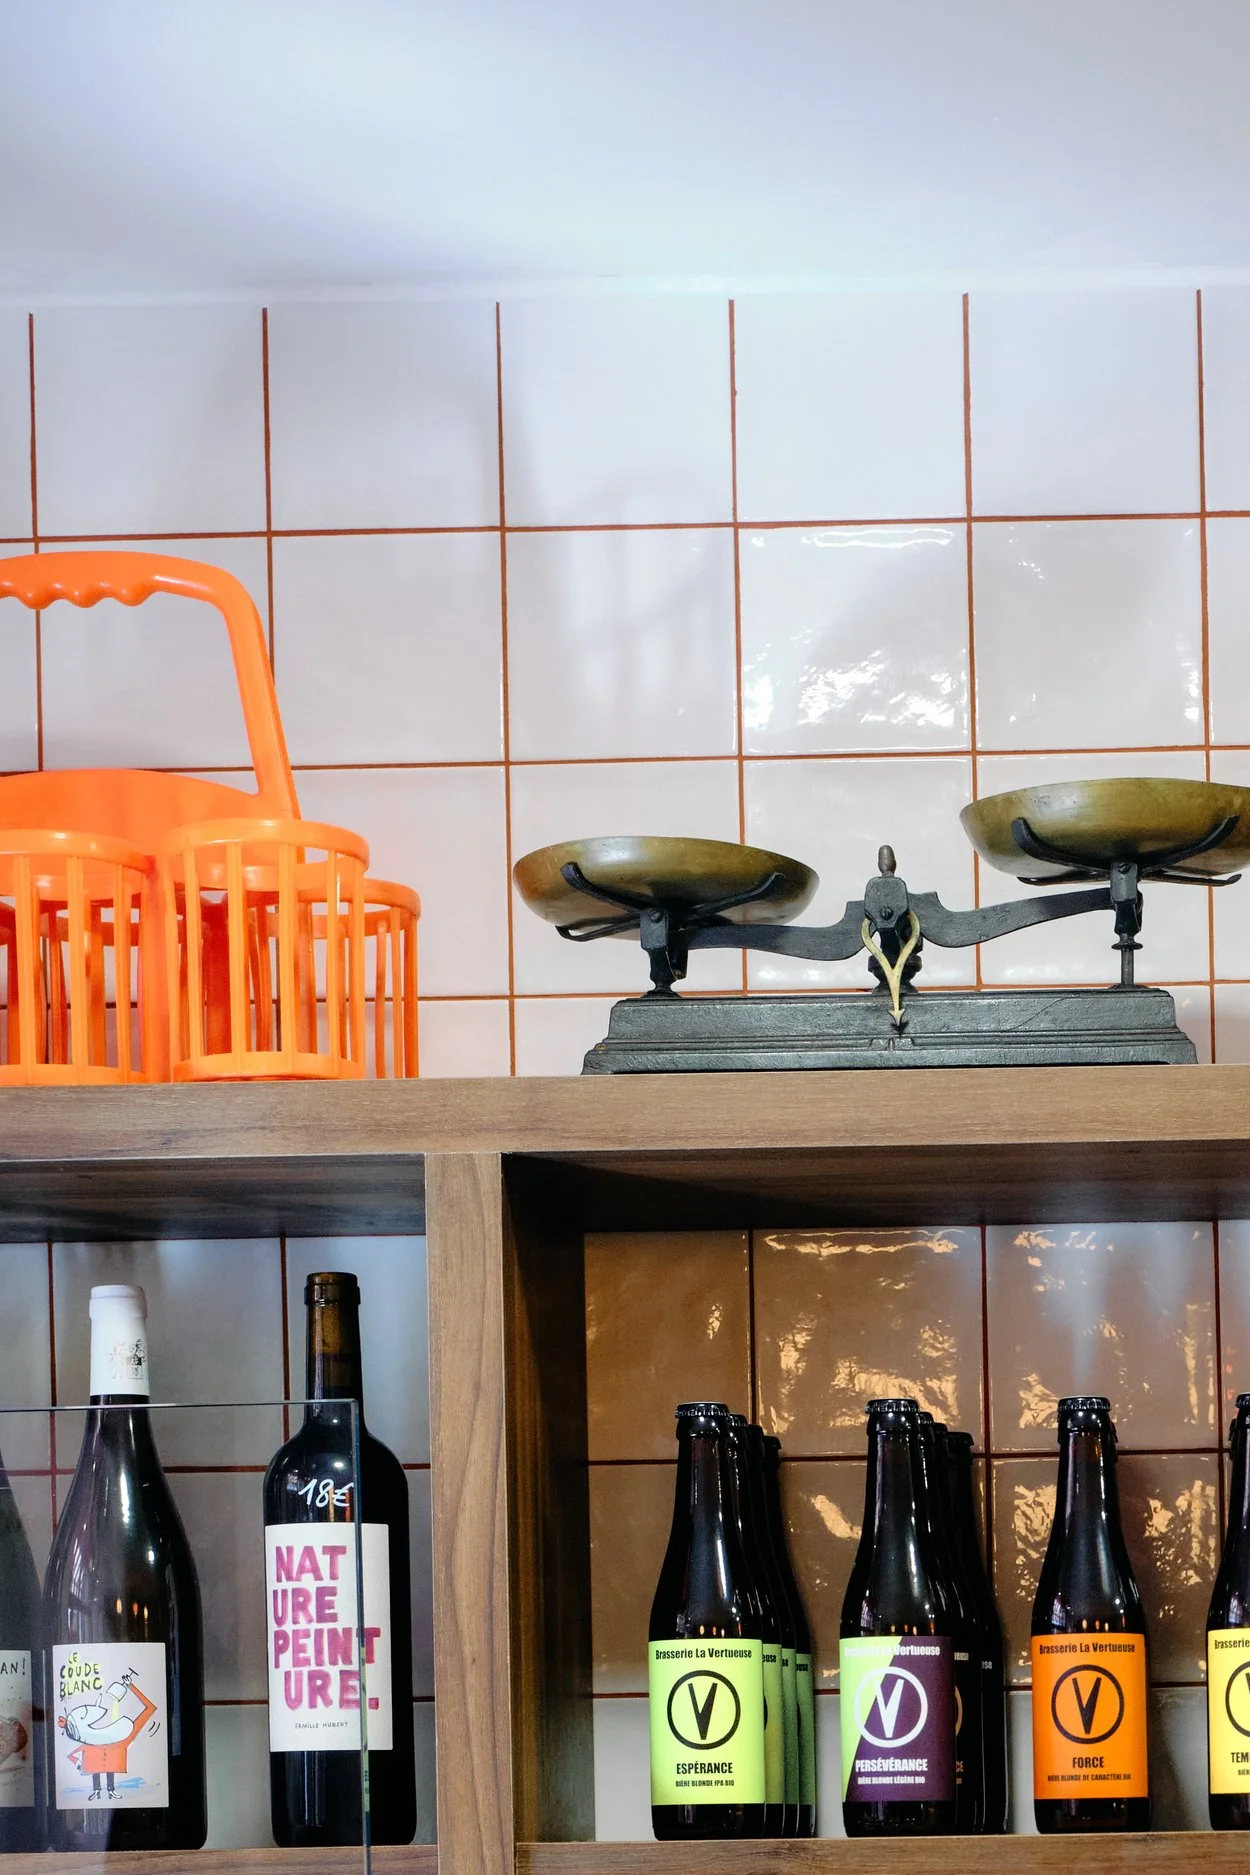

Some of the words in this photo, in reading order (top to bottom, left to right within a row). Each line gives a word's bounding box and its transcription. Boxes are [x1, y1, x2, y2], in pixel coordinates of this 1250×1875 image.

[275, 1545, 347, 1583] NAT
[272, 1586, 338, 1628] URE
[274, 1627, 381, 1669] PEINT
[1040, 1644, 1077, 1654] Brasserie
[1080, 1643, 1089, 1652] La
[1092, 1643, 1135, 1652] Vertueuse
[1215, 1638, 1250, 1649] Brasserie
[656, 1649, 692, 1659] Brasserie
[696, 1649, 705, 1657] La
[708, 1648, 752, 1658] Vertueuse
[894, 1645, 940, 1656] Vertueuse
[60, 1663, 100, 1679] COUDE
[60, 1677, 102, 1698] BLANC
[295, 1721, 319, 1729] FAMILLE
[677, 1761, 732, 1774] ESPÉRANCE
[856, 1757, 928, 1772] PERSÉVÉRANCE
[1072, 1757, 1104, 1768] FORCE
